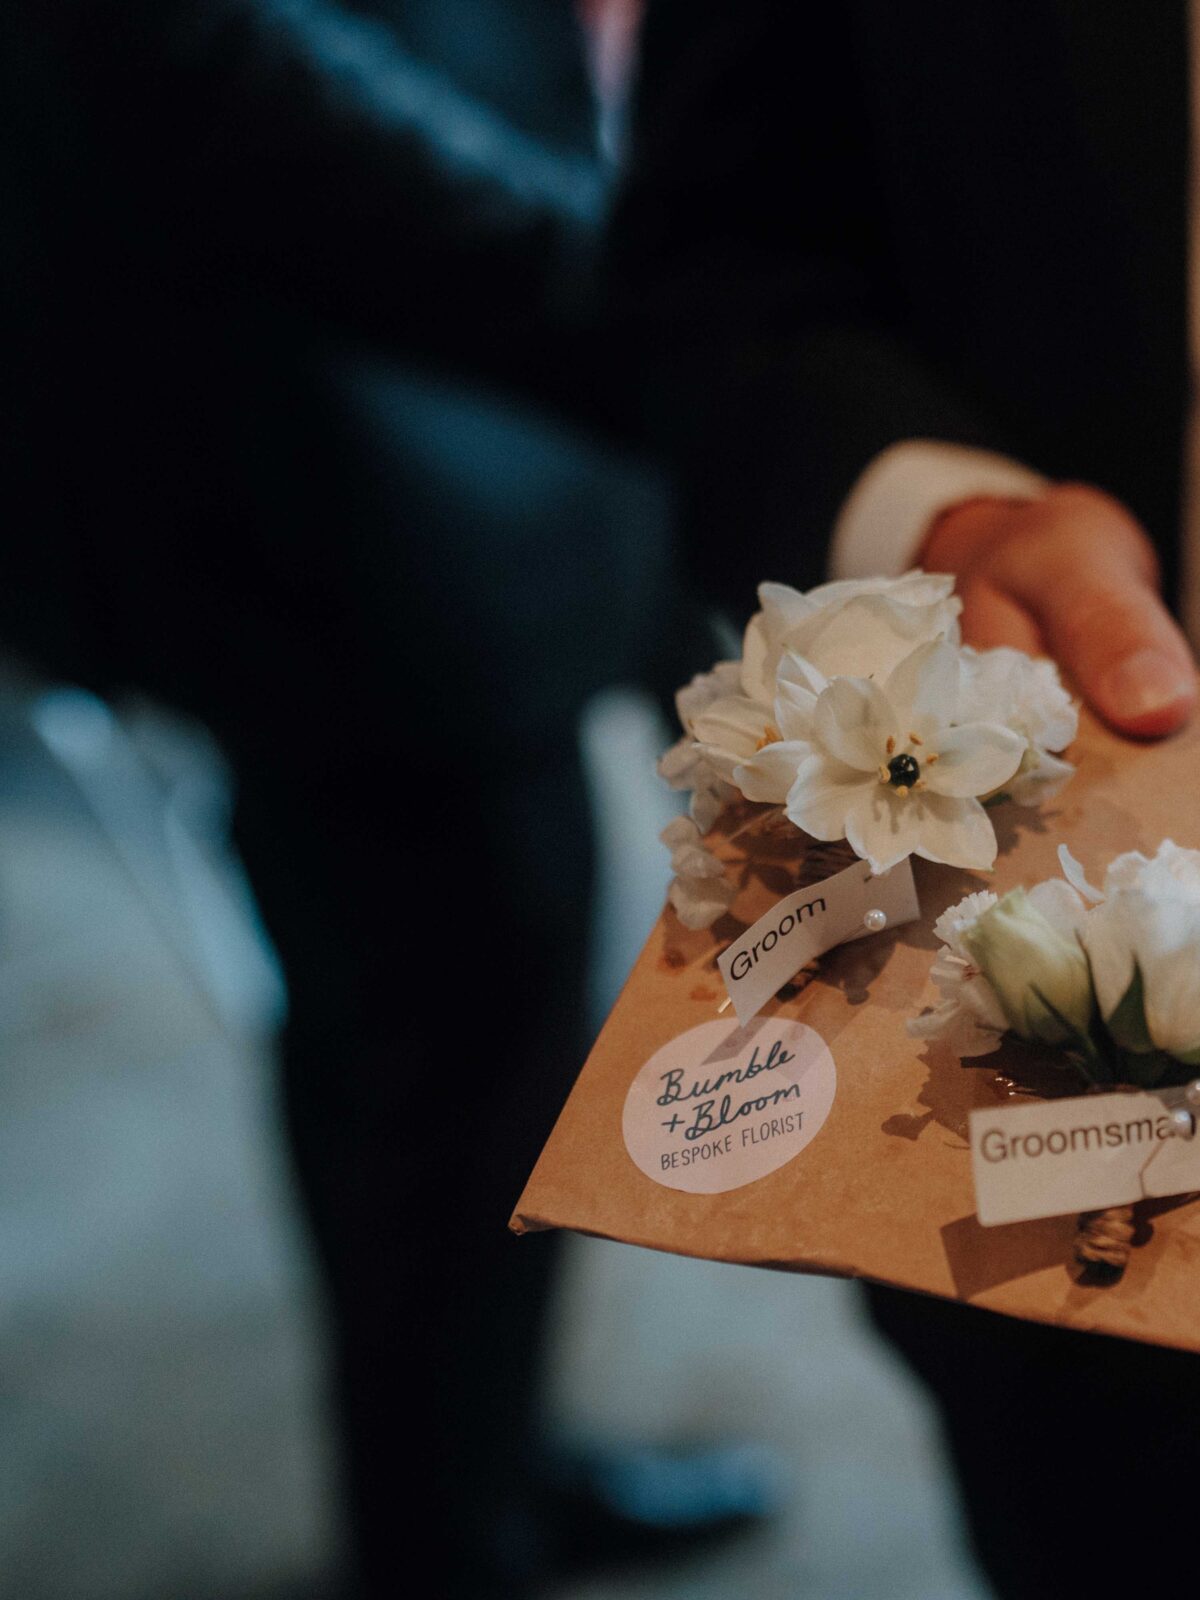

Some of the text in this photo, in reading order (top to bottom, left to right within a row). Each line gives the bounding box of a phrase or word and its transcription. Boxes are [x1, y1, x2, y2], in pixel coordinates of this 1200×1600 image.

[729, 896, 827, 982] Groom
[656, 1040, 796, 1107] Bumble
[660, 1111, 805, 1171] BESPOKE FLORIST
